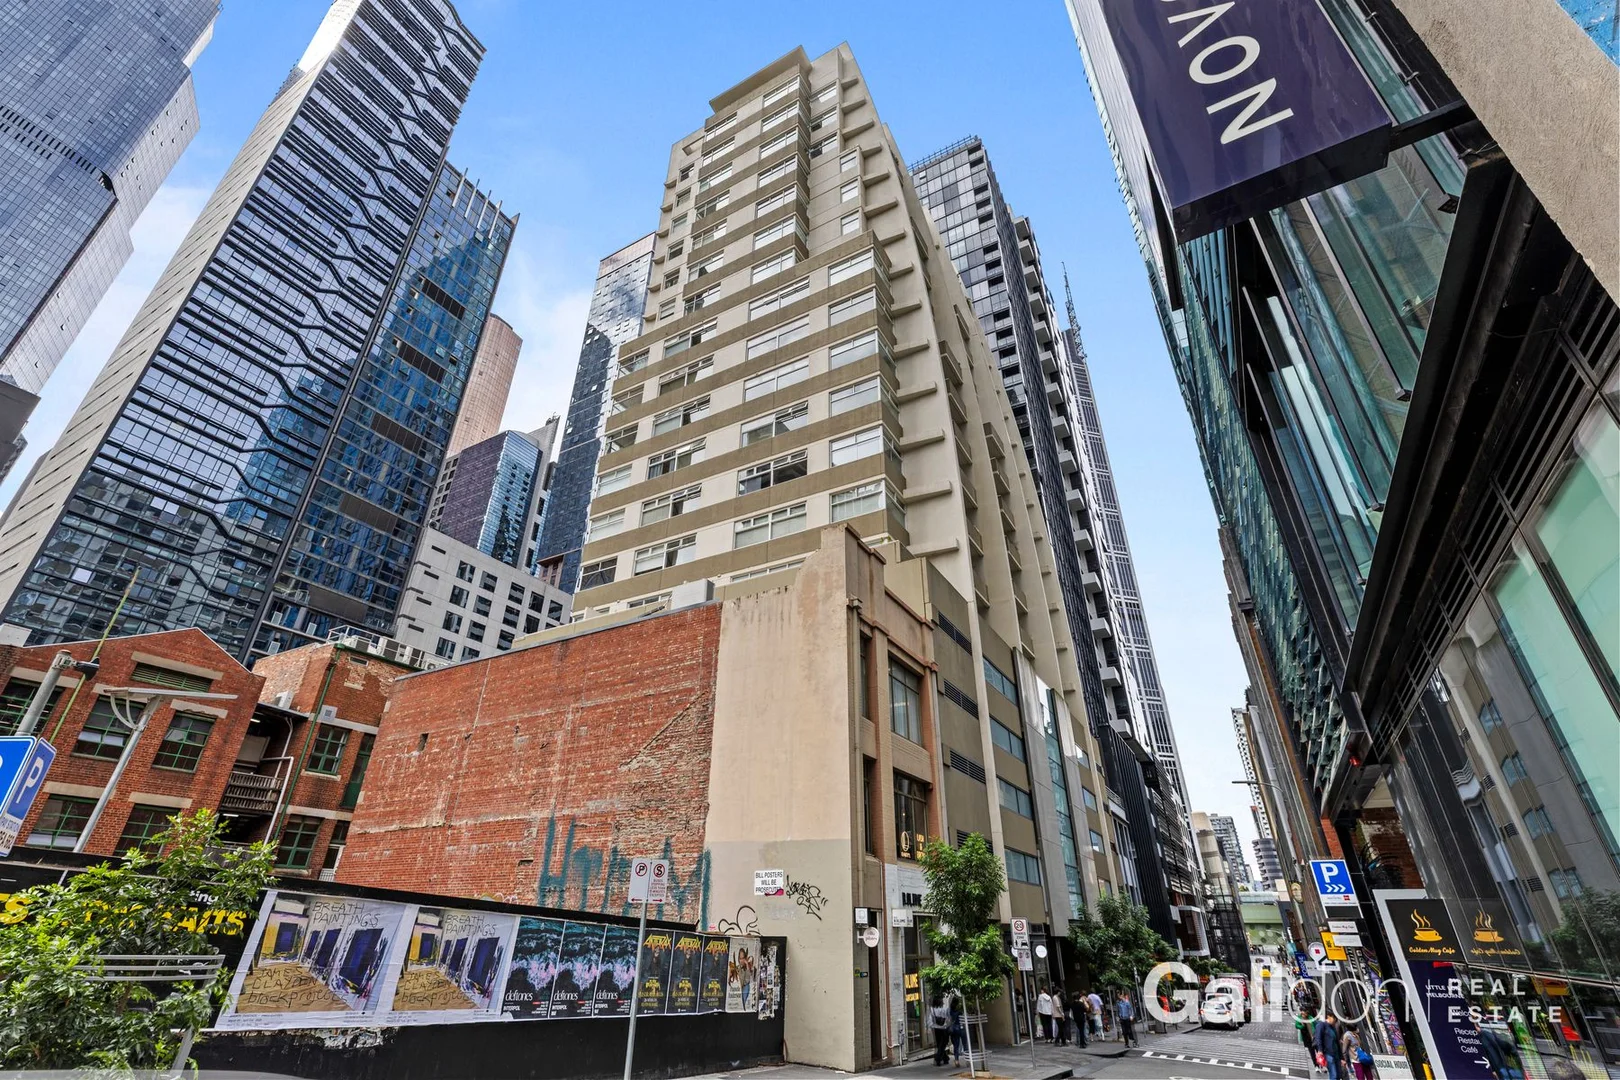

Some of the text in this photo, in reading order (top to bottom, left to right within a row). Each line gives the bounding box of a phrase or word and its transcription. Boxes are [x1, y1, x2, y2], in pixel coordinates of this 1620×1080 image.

[1162, 0, 1295, 144] NOV
[16, 756, 44, 804] P
[1320, 863, 1339, 883] P
[312, 901, 365, 914] BREATH
[312, 912, 381, 928] PAINTINGS
[444, 914, 485, 925] BREATH
[445, 923, 498, 937] PAINTINGS
[259, 968, 304, 978] JAMES
[505, 990, 533, 1001] deftones
[553, 990, 579, 1001] deftones
[596, 989, 618, 1000] deftones
[1374, 1059, 1409, 1069] SOCIAL HOUR
